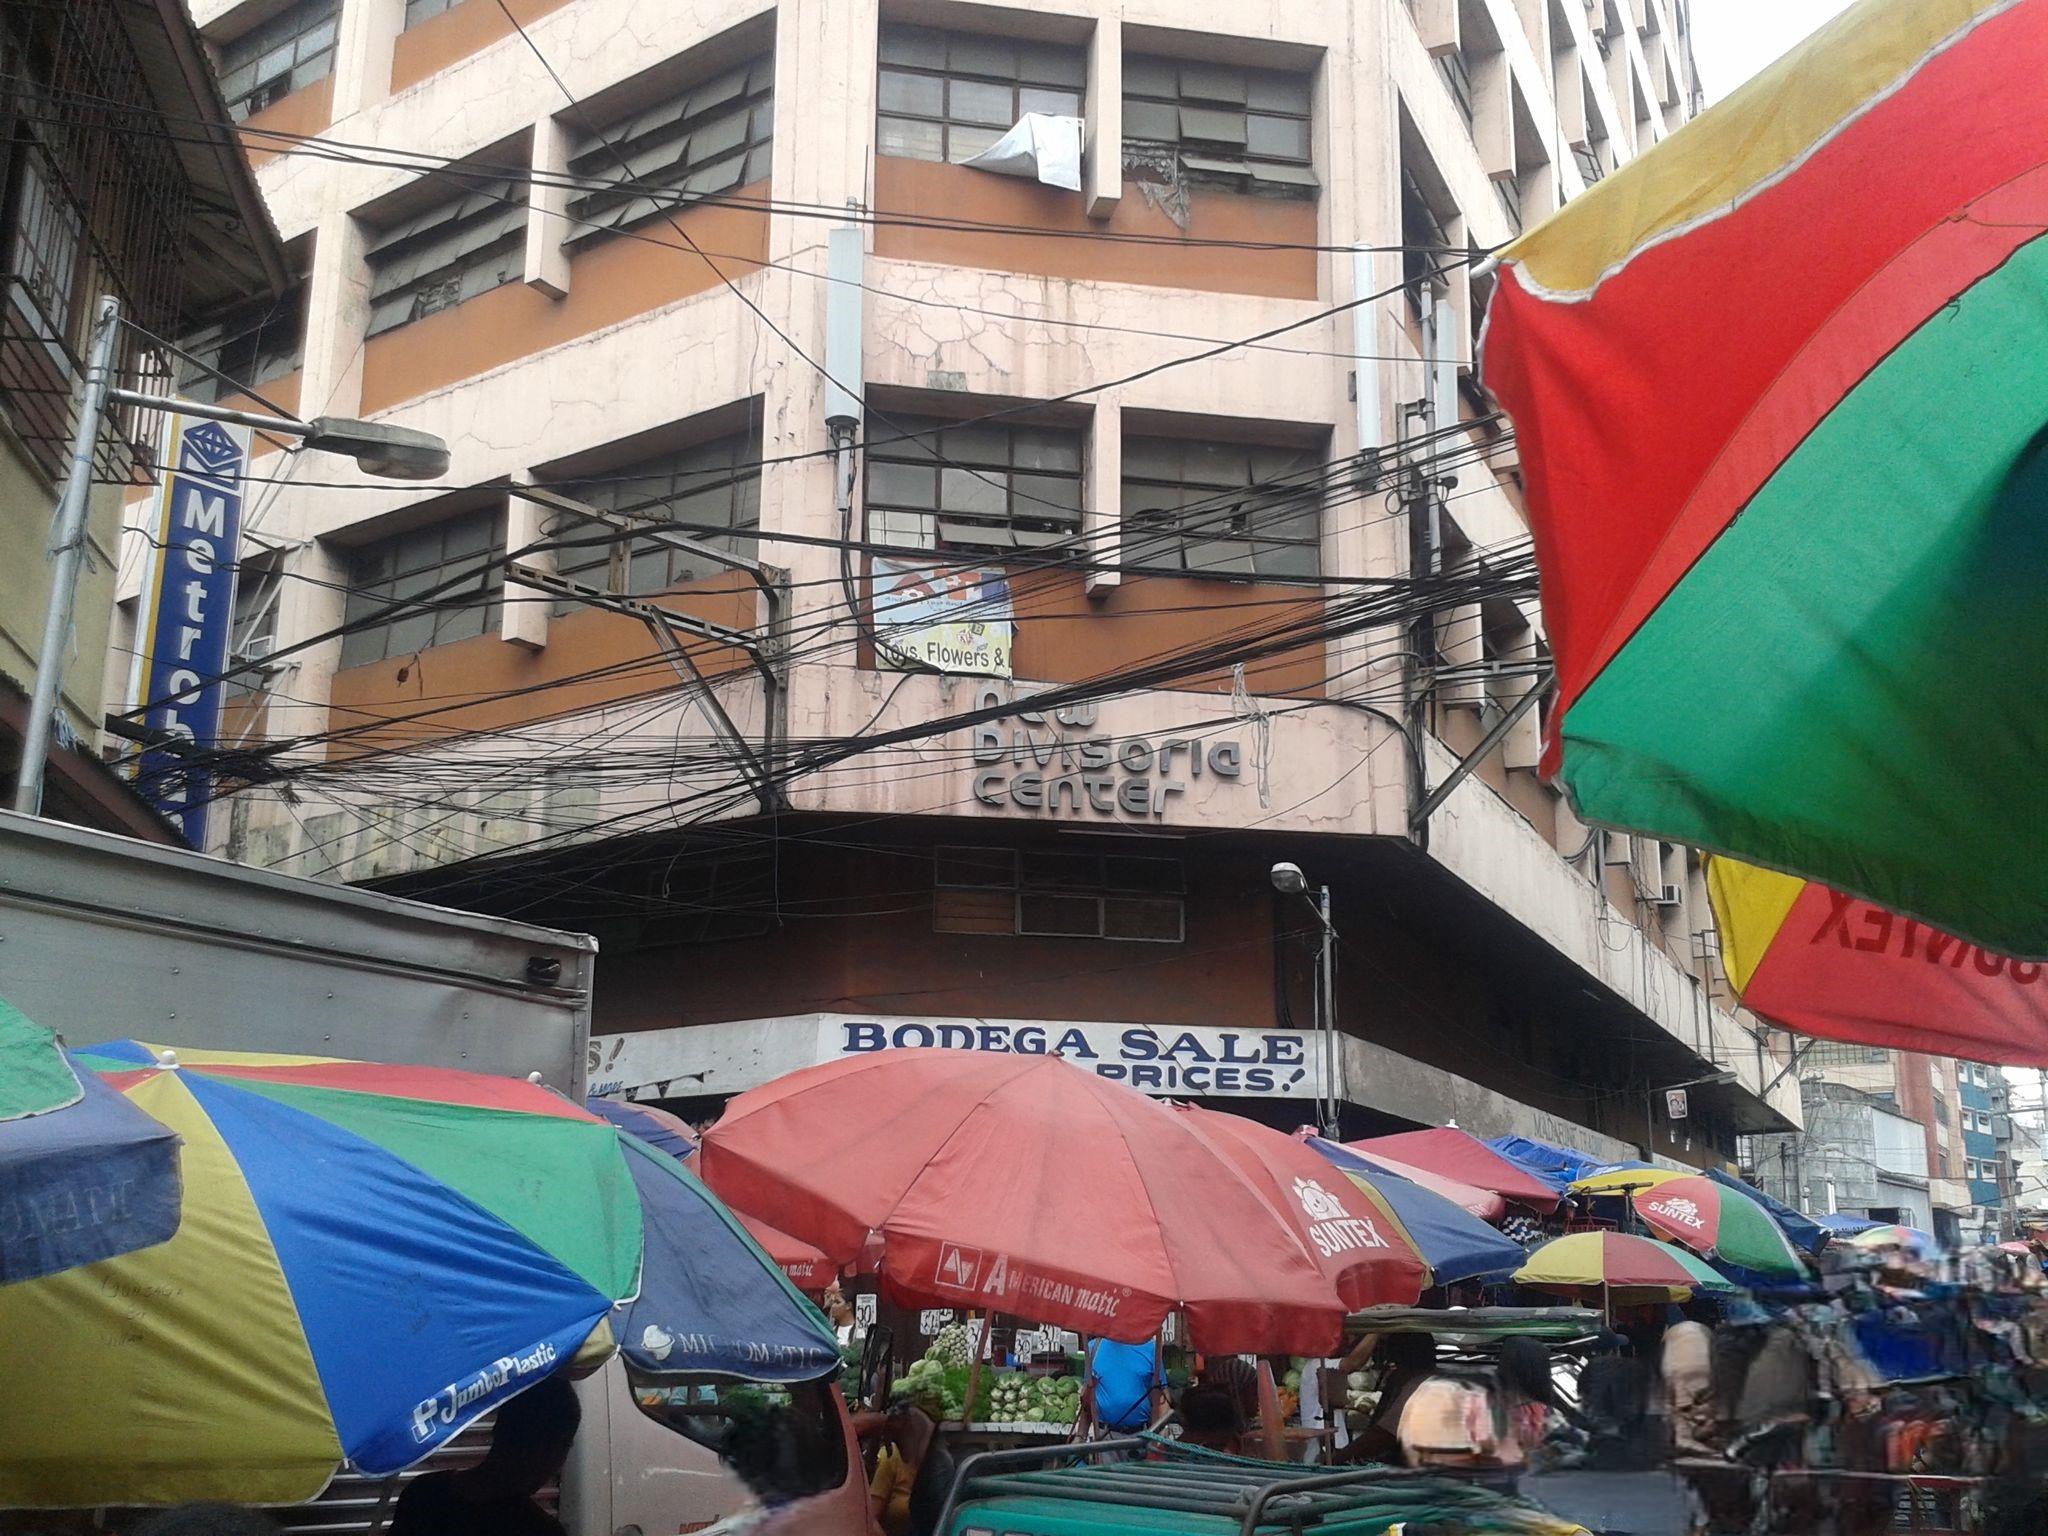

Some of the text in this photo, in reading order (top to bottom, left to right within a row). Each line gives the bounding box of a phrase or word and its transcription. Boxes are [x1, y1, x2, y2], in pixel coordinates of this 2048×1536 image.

[926, 641, 990, 668] Flowers
[994, 647, 1005, 668] &
[842, 1022, 1305, 1066] BODEGA SALE
[1096, 1063, 1306, 1093] PRICES!
[1648, 1200, 1704, 1230] SUNTEX
[1309, 1218, 1390, 1257] SUNTEX
[982, 1254, 1073, 1306] AMERICAN
